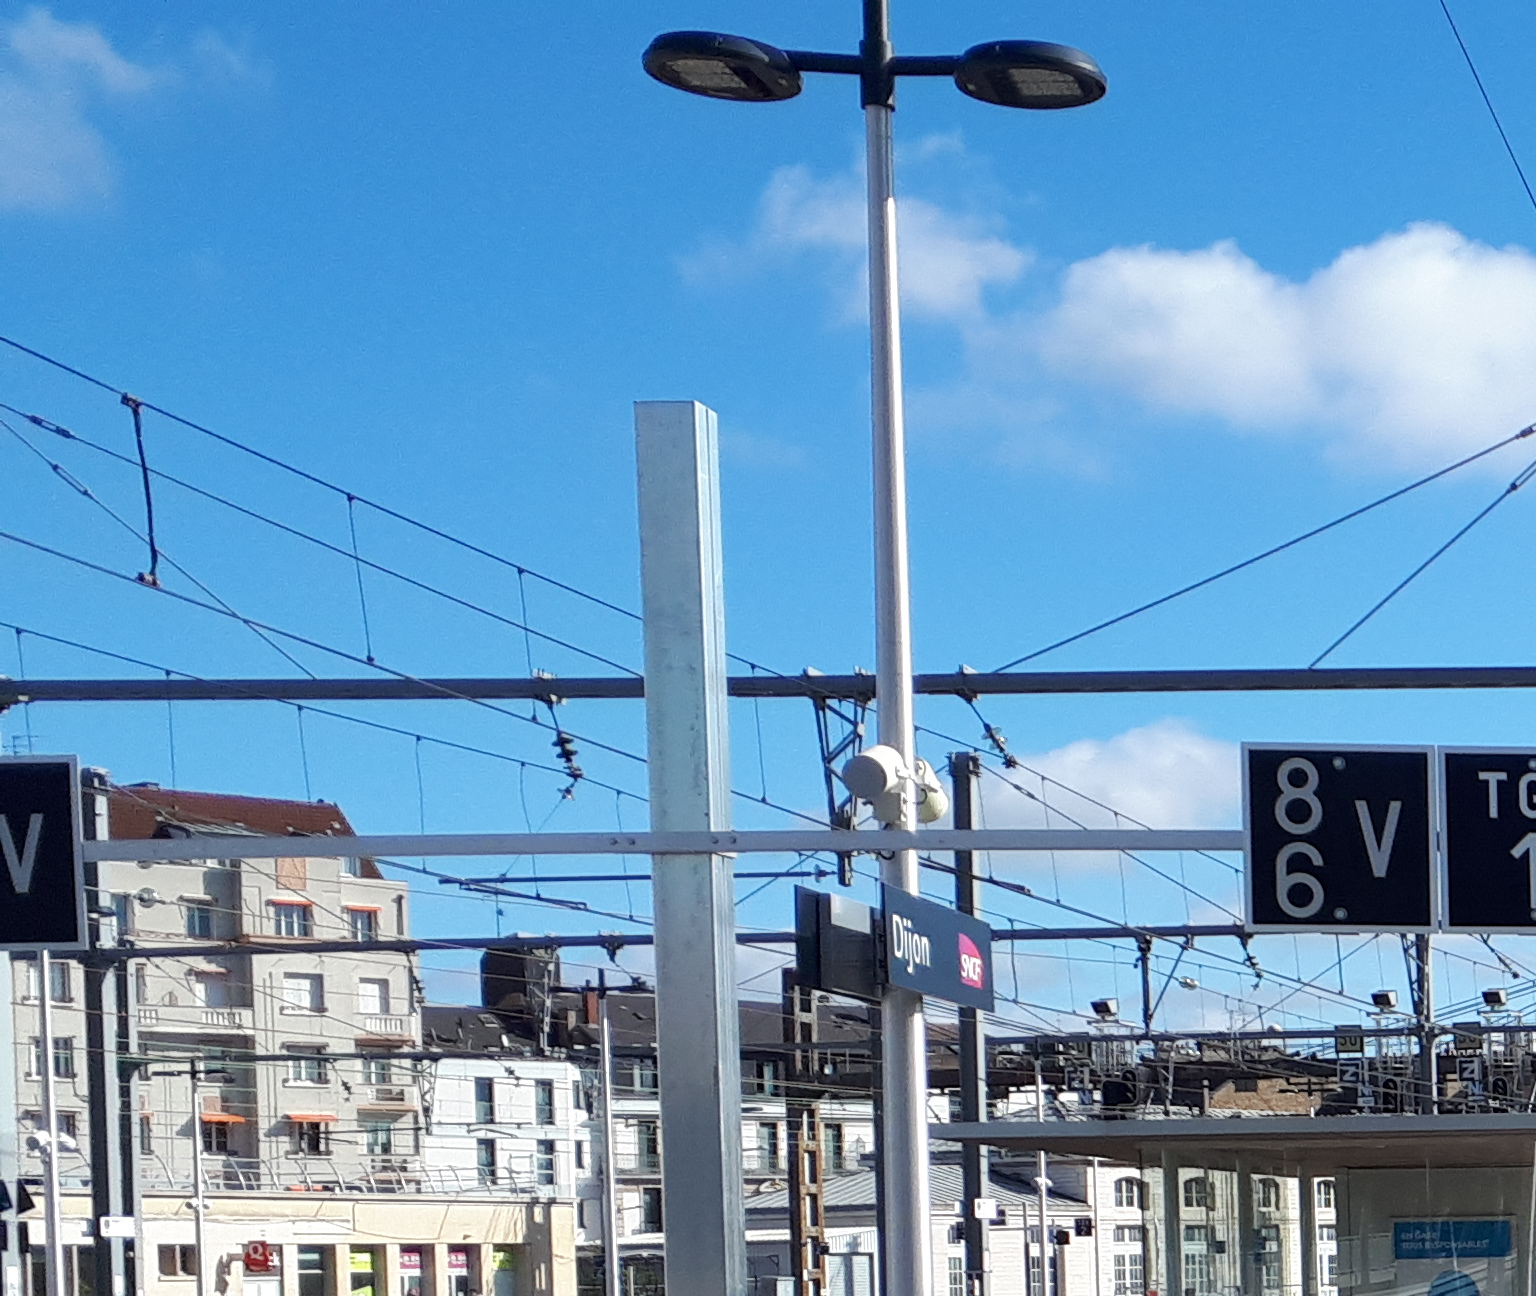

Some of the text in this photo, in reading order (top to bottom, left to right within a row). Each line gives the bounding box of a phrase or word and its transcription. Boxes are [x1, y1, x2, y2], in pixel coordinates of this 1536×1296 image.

[1275, 757, 1323, 835] 8
[0, 812, 43, 894] V
[1354, 800, 1402, 878] V
[1275, 841, 1325, 918] 6
[892, 914, 931, 975] Dijon
[961, 954, 985, 981] SNCF
